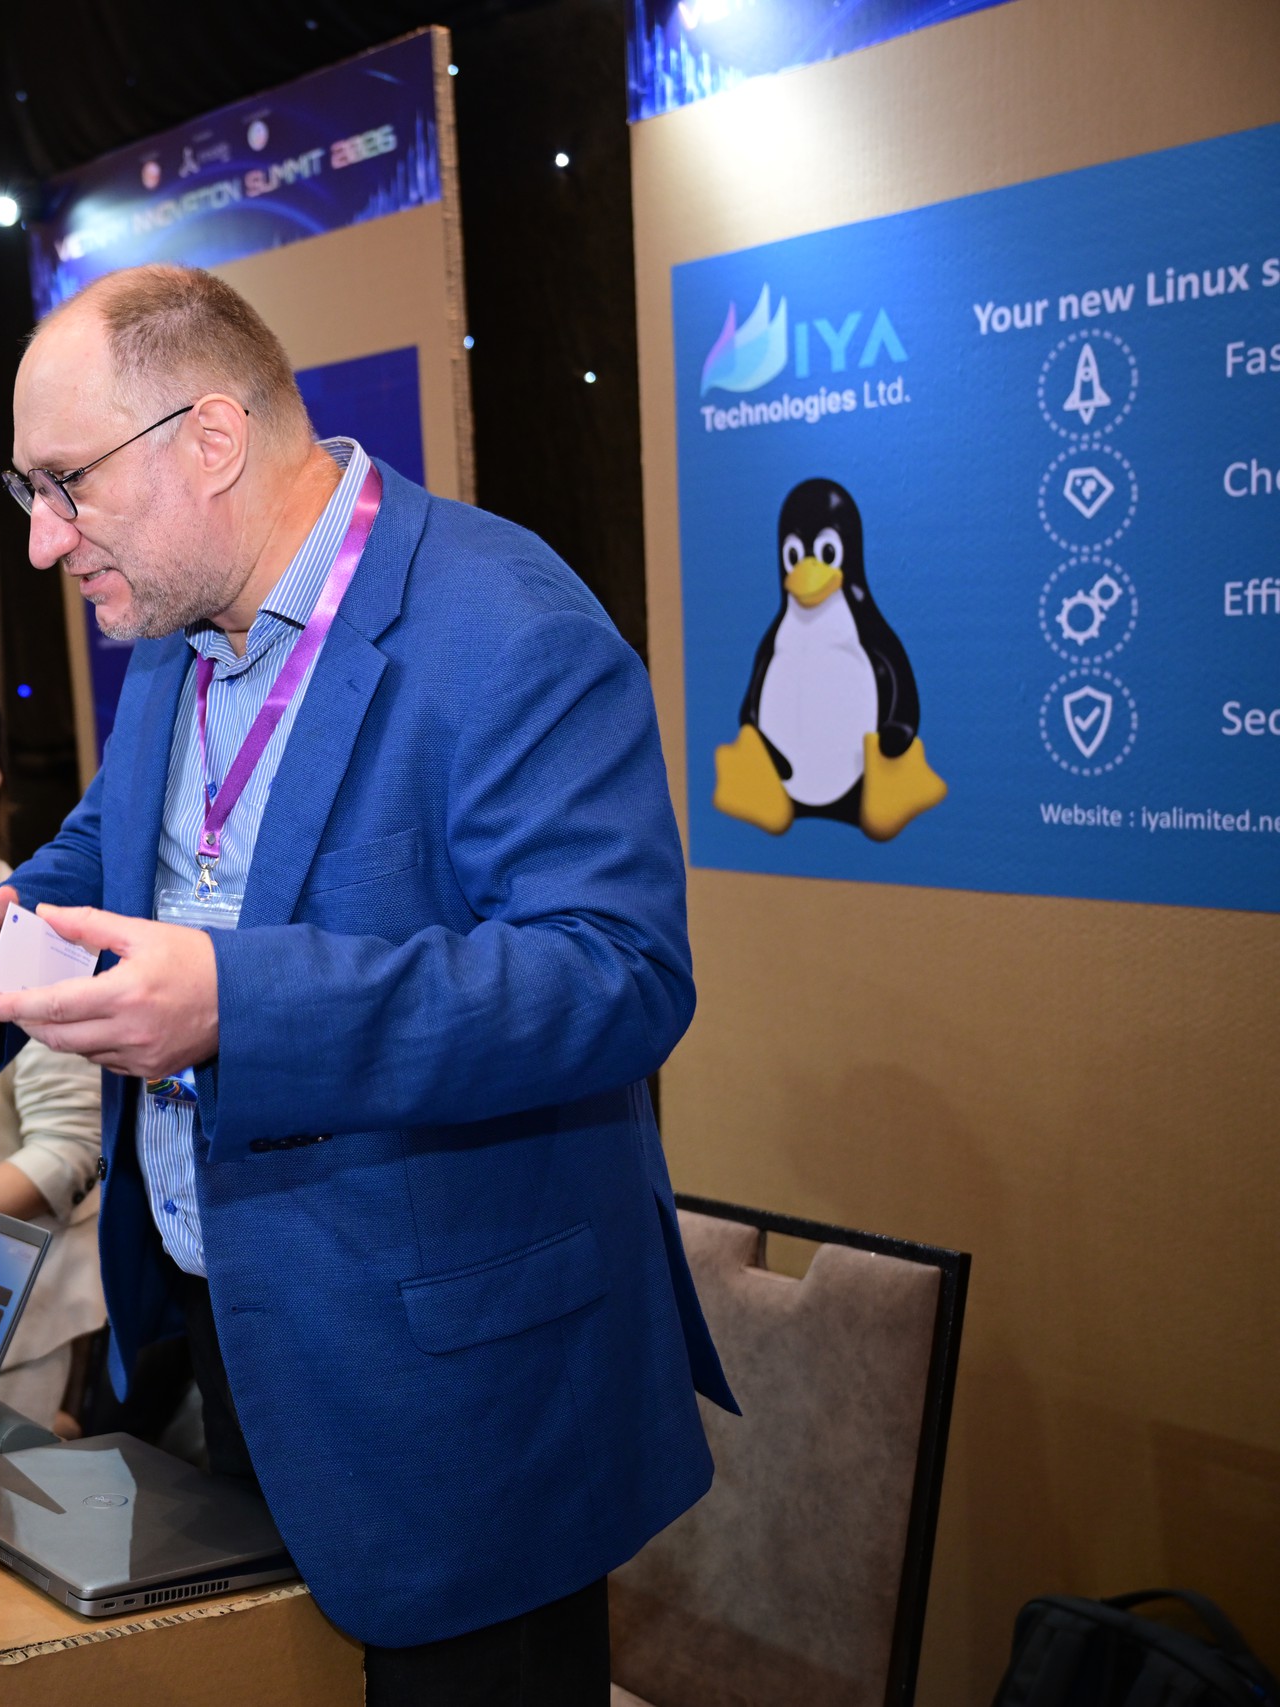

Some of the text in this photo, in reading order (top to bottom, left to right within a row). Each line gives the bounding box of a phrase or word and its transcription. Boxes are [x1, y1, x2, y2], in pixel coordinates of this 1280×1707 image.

[244, 148, 326, 198] SUMMIT
[973, 257, 1280, 336] Your new Linux s
[793, 306, 910, 379] IYA
[1225, 340, 1280, 378] Fas
[699, 375, 912, 432] Technologies Ltd.
[1223, 457, 1280, 498] Ch
[1220, 699, 1280, 737] Sec
[1039, 802, 1123, 828] Website
